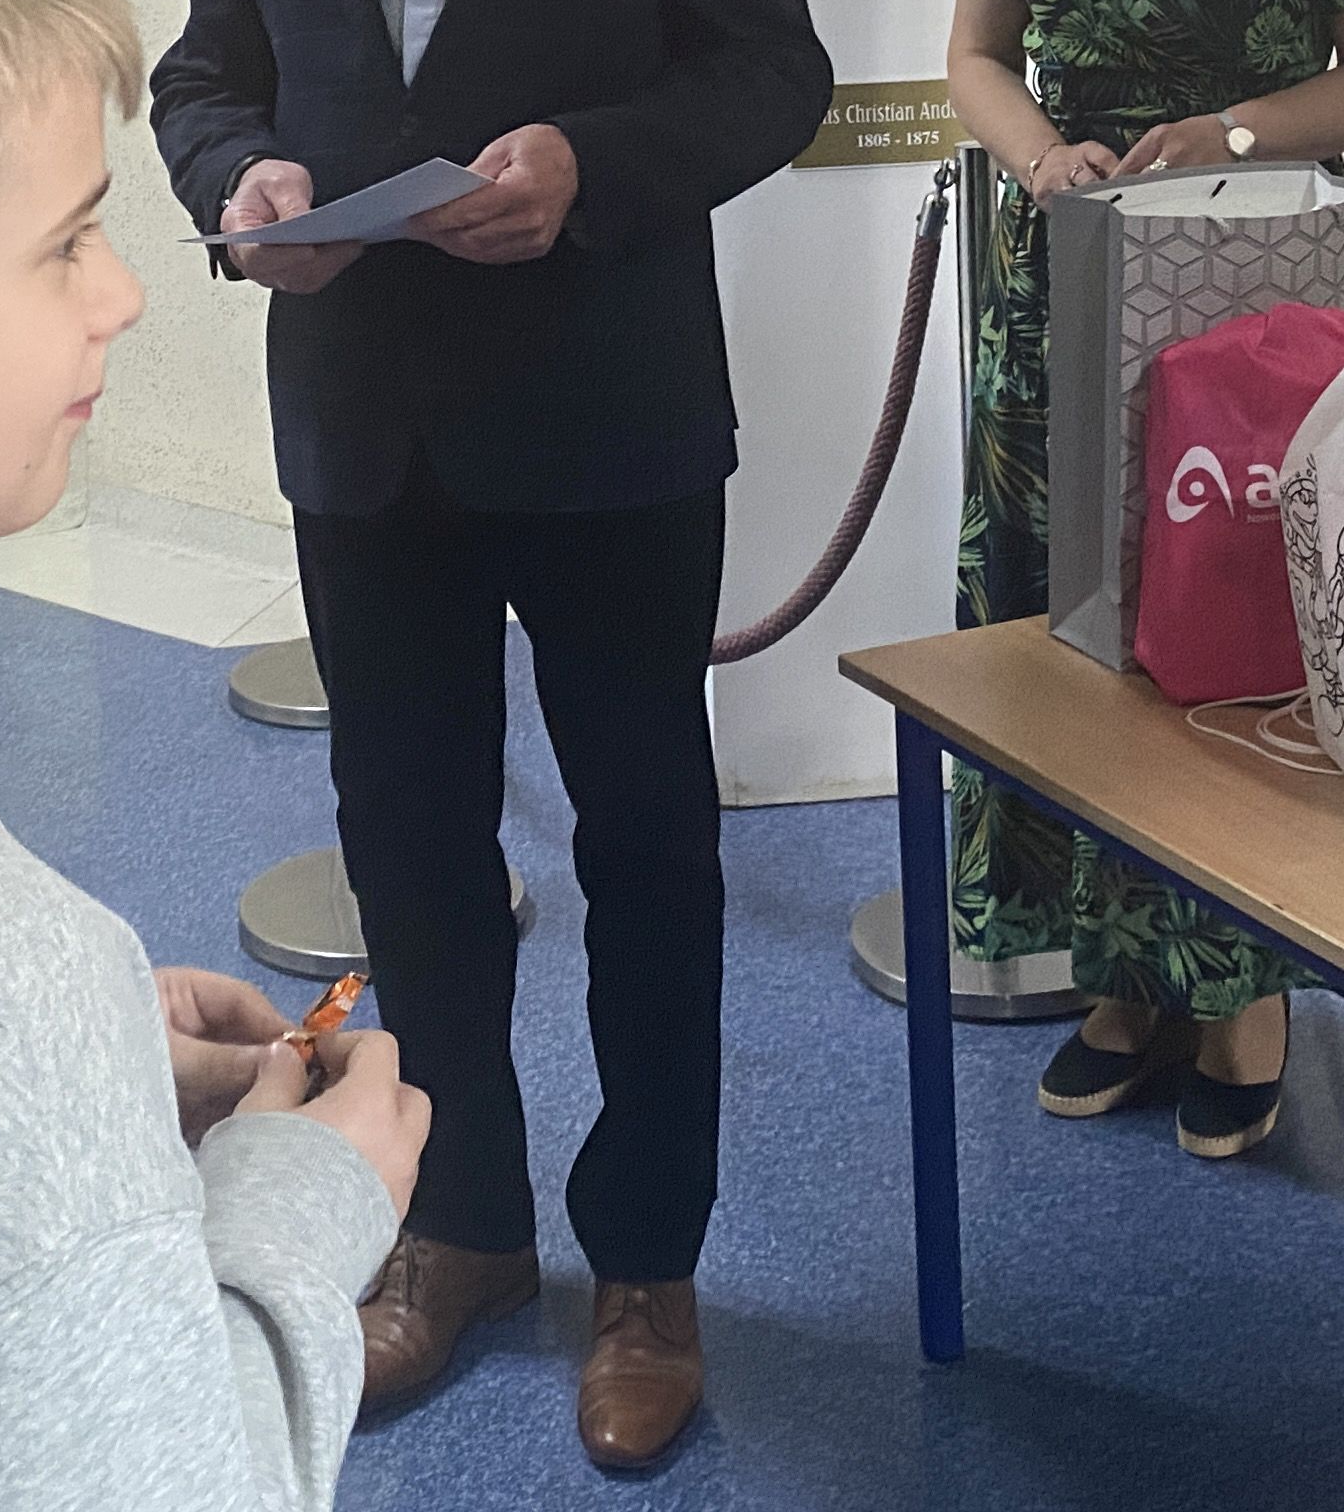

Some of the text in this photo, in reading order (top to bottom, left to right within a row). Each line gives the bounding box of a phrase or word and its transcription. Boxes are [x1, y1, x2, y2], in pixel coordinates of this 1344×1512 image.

[846, 102, 914, 124] Christian
[857, 133, 891, 148] 1805
[906, 131, 940, 146] 1875
